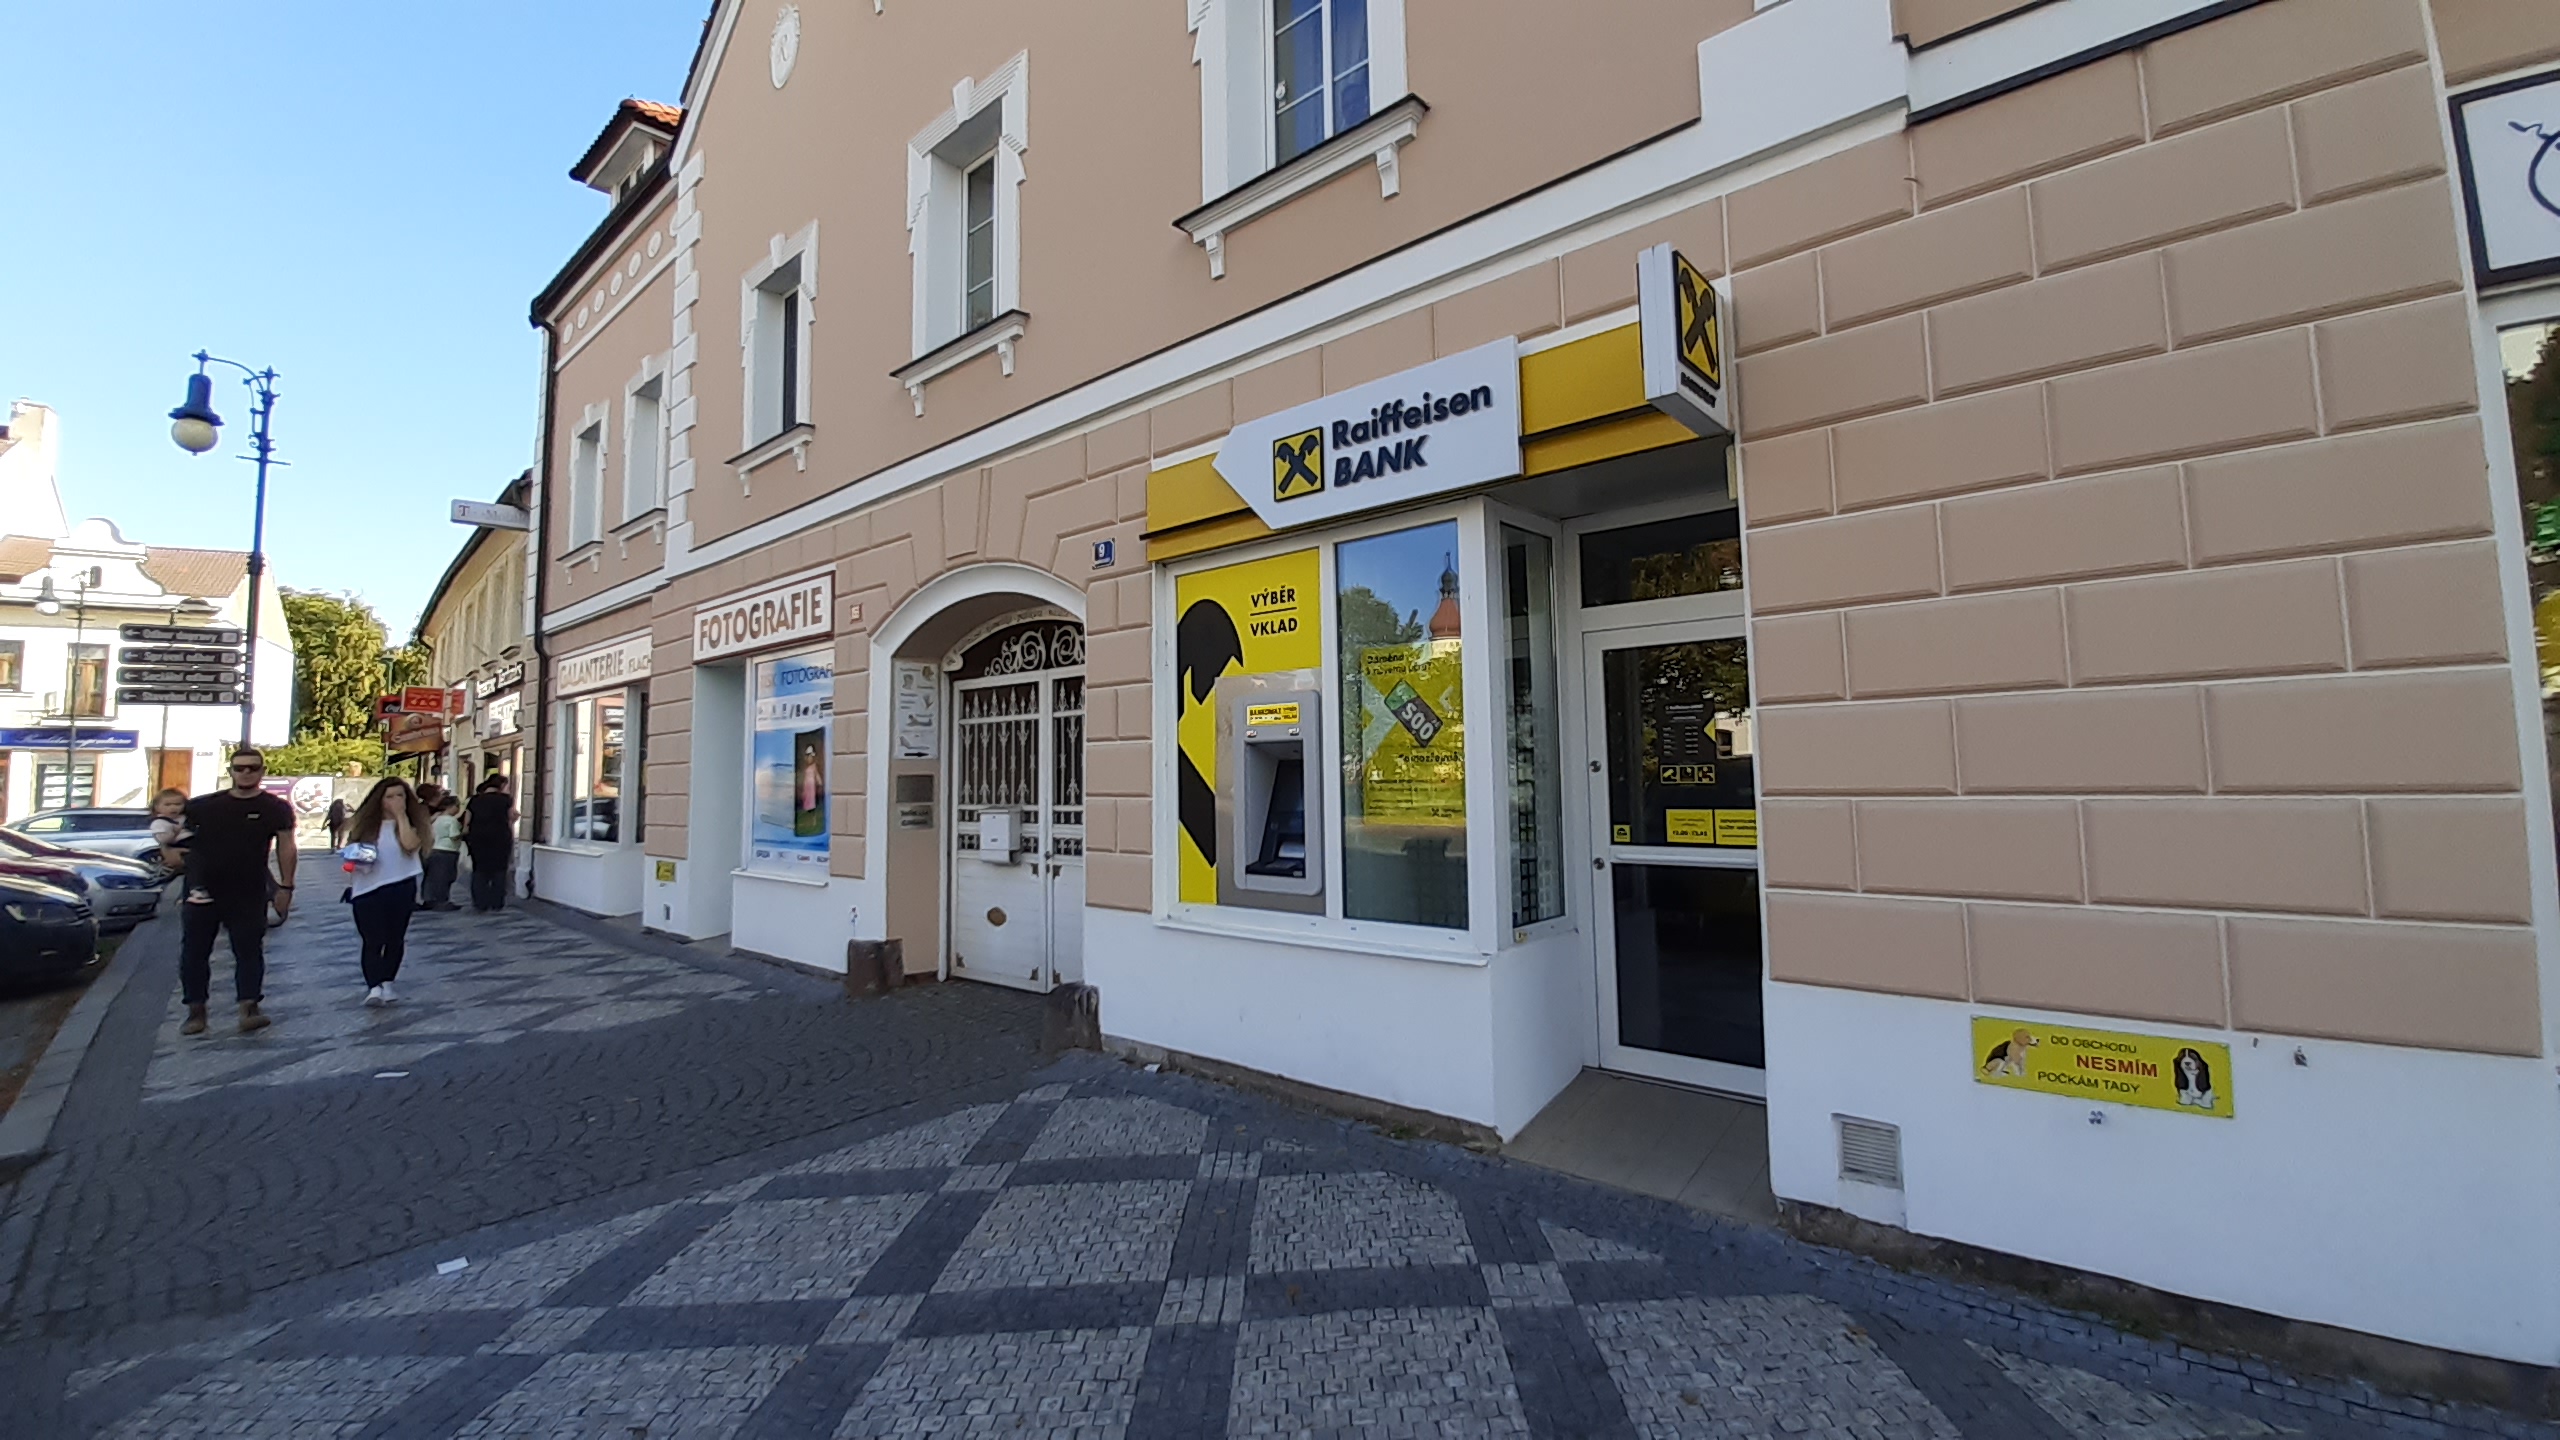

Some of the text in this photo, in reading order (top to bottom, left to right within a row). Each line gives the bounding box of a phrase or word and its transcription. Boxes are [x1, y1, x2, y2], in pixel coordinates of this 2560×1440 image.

[1332, 385, 1492, 450] Raiffeisen
[1334, 434, 1430, 487] BANK
[1099, 544, 1105, 557] 9
[1251, 585, 1296, 608] VÝBĚR
[700, 586, 823, 651] FOTOGRAFIE
[1250, 617, 1298, 637] VKLAD
[560, 649, 625, 690] GALANTERIE
[1401, 702, 1434, 740] 500
[2050, 1035, 2137, 1054] DO OBCHODU
[2076, 1054, 2158, 1078] NESMÍM
[2037, 1070, 2141, 1094] POČKÁM TADY
